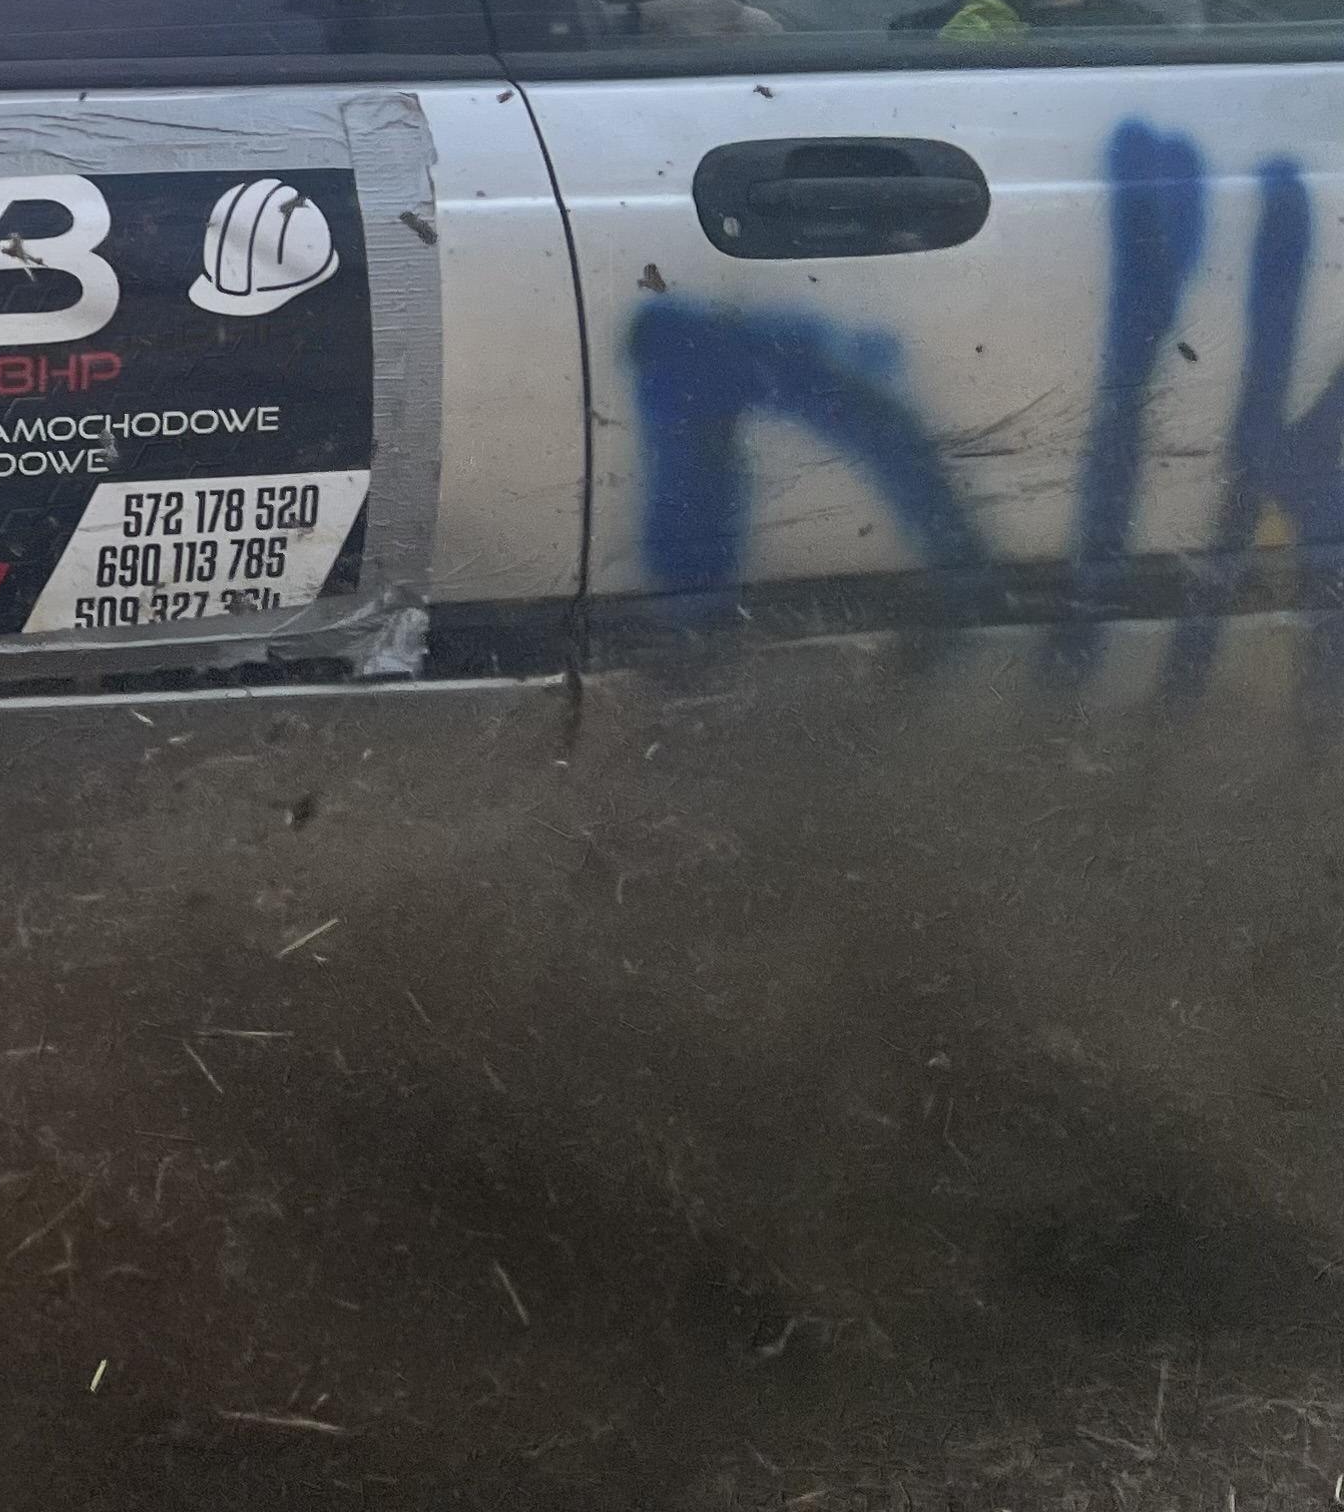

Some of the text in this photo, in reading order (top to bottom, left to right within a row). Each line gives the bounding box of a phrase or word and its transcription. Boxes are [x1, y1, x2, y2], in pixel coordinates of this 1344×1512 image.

[123, 484, 320, 538] 572 178 520
[96, 537, 288, 588] 690 113 785
